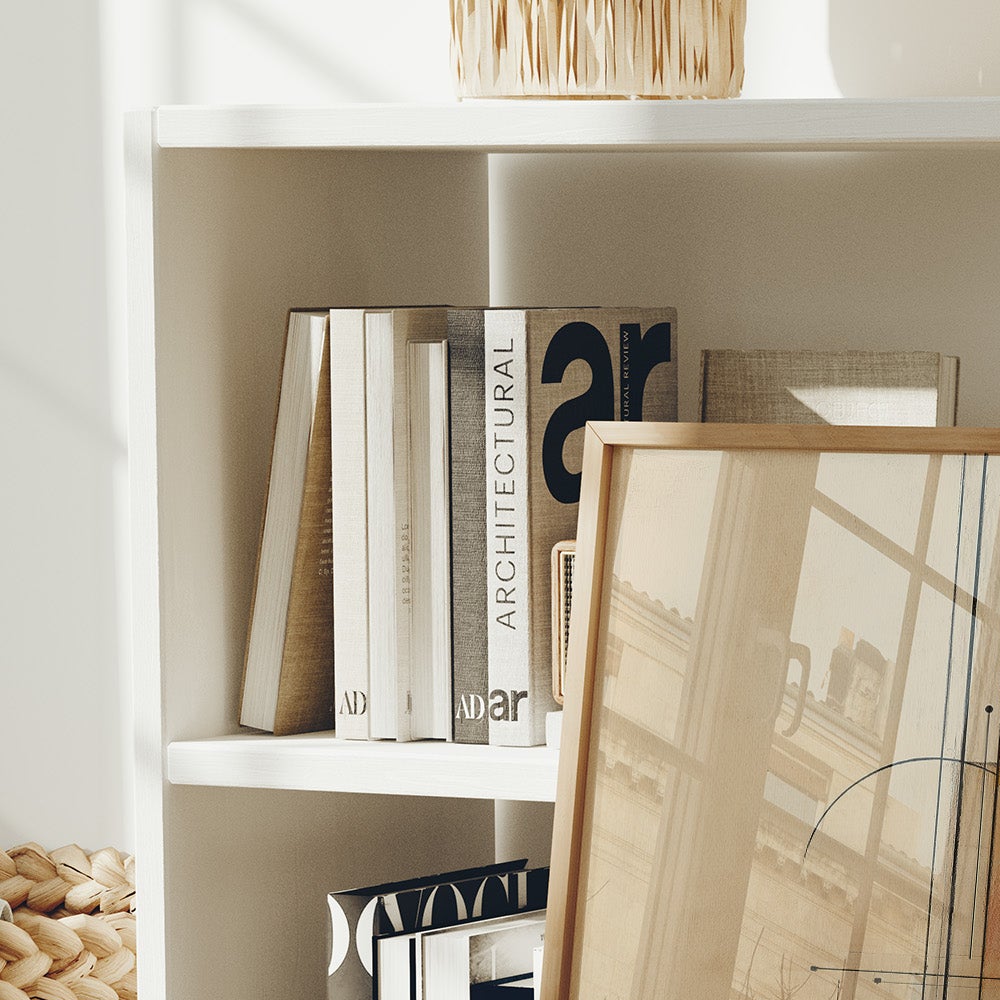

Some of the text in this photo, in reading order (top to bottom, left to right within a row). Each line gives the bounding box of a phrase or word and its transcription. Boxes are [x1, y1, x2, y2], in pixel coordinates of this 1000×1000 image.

[493, 338, 516, 630] ARCHITECTURAL
[339, 690, 367, 716] AD
[455, 693, 486, 721] AD
[489, 688, 529, 722] ar
